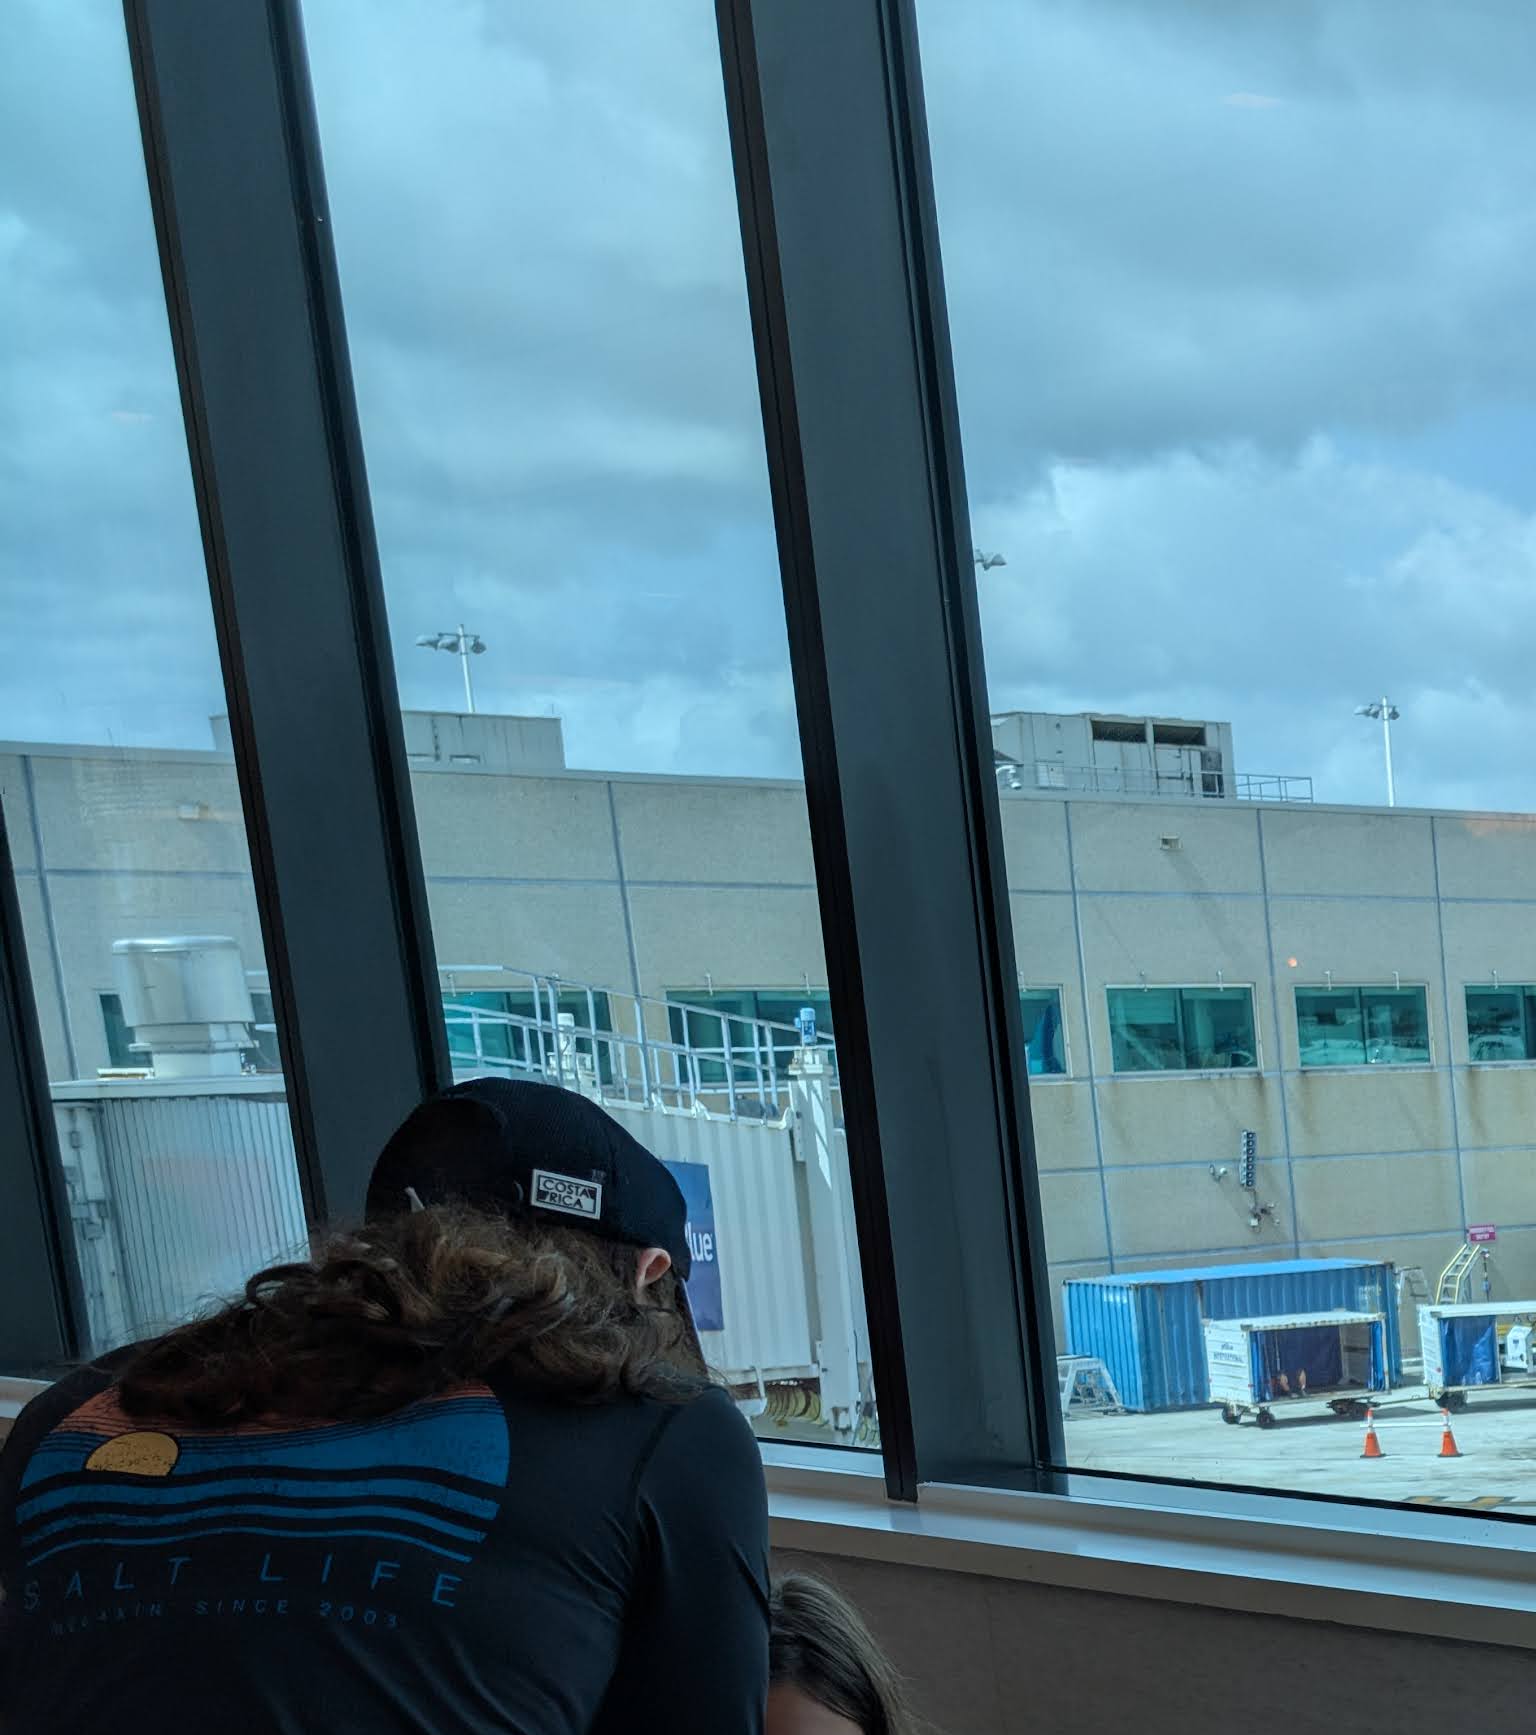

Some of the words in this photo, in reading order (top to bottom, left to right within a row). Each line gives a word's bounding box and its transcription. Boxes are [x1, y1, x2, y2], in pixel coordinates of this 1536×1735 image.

[543, 1178, 592, 1200] COSTA
[550, 1191, 584, 1209] RICA
[23, 1556, 192, 1611] SALT
[260, 1553, 463, 1608] LIFE
[193, 1599, 289, 1617] SINCE
